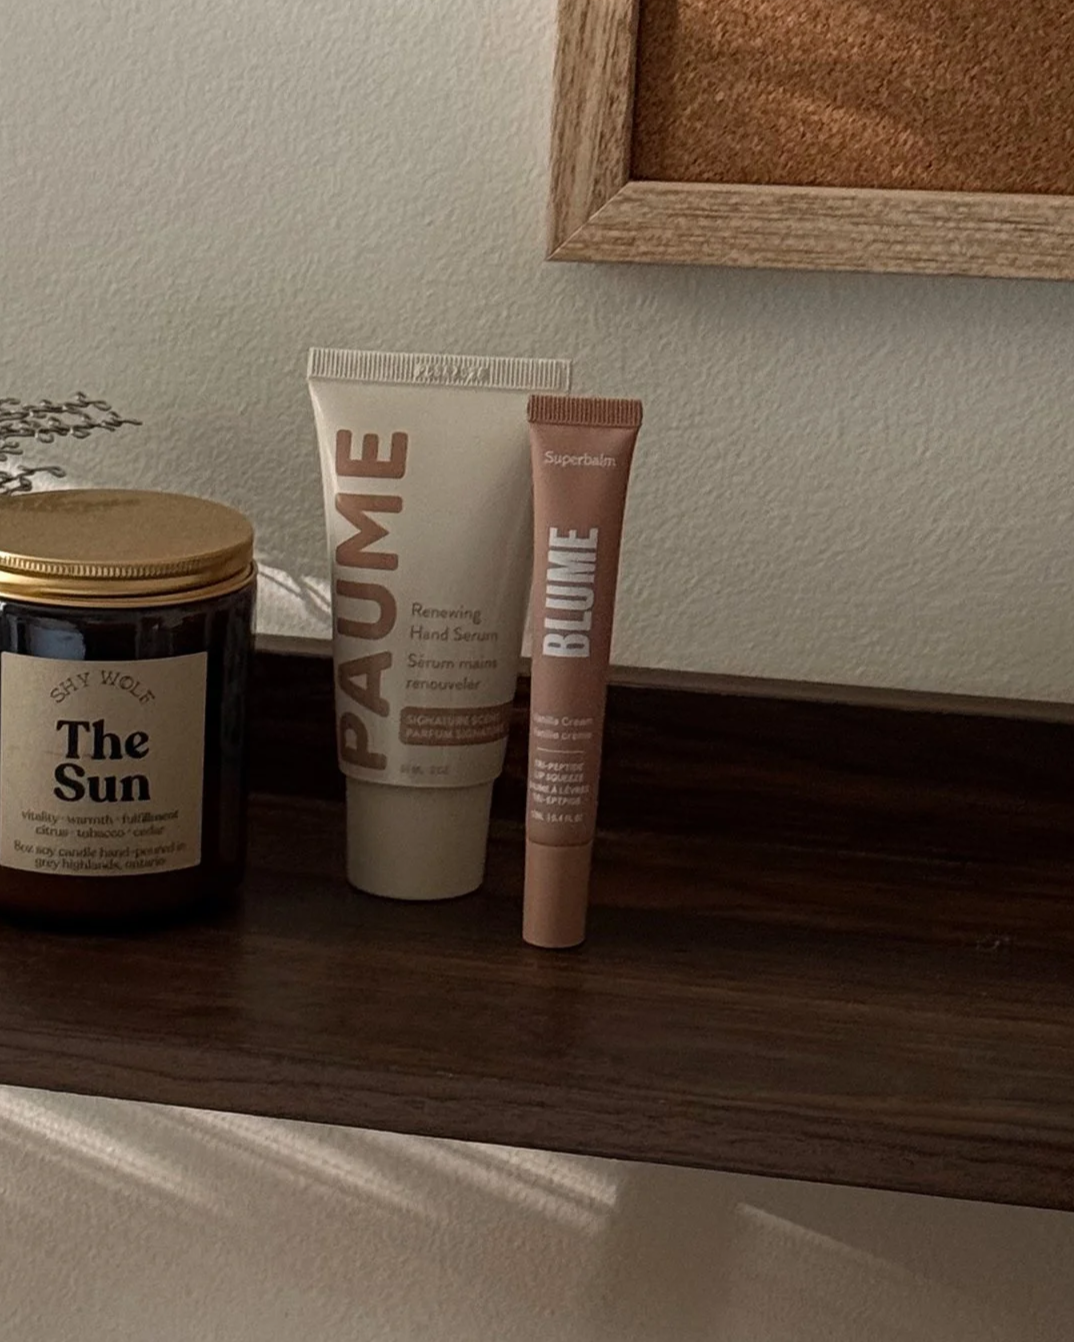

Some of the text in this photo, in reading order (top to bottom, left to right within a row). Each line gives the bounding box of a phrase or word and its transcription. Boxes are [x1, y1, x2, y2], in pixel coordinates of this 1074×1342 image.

[545, 450, 616, 467] Superbalm
[335, 429, 408, 770] PAUME
[542, 527, 599, 658] BLUME
[412, 602, 482, 625] Renewing
[410, 624, 498, 642] Hand Serum
[459, 658, 498, 670] mains
[50, 669, 155, 706] SHY WOLF
[56, 718, 149, 760] The
[54, 763, 151, 803] Sun
[21, 810, 58, 826] vitality
[68, 813, 114, 826] warmth
[34, 824, 69, 837] citrus
